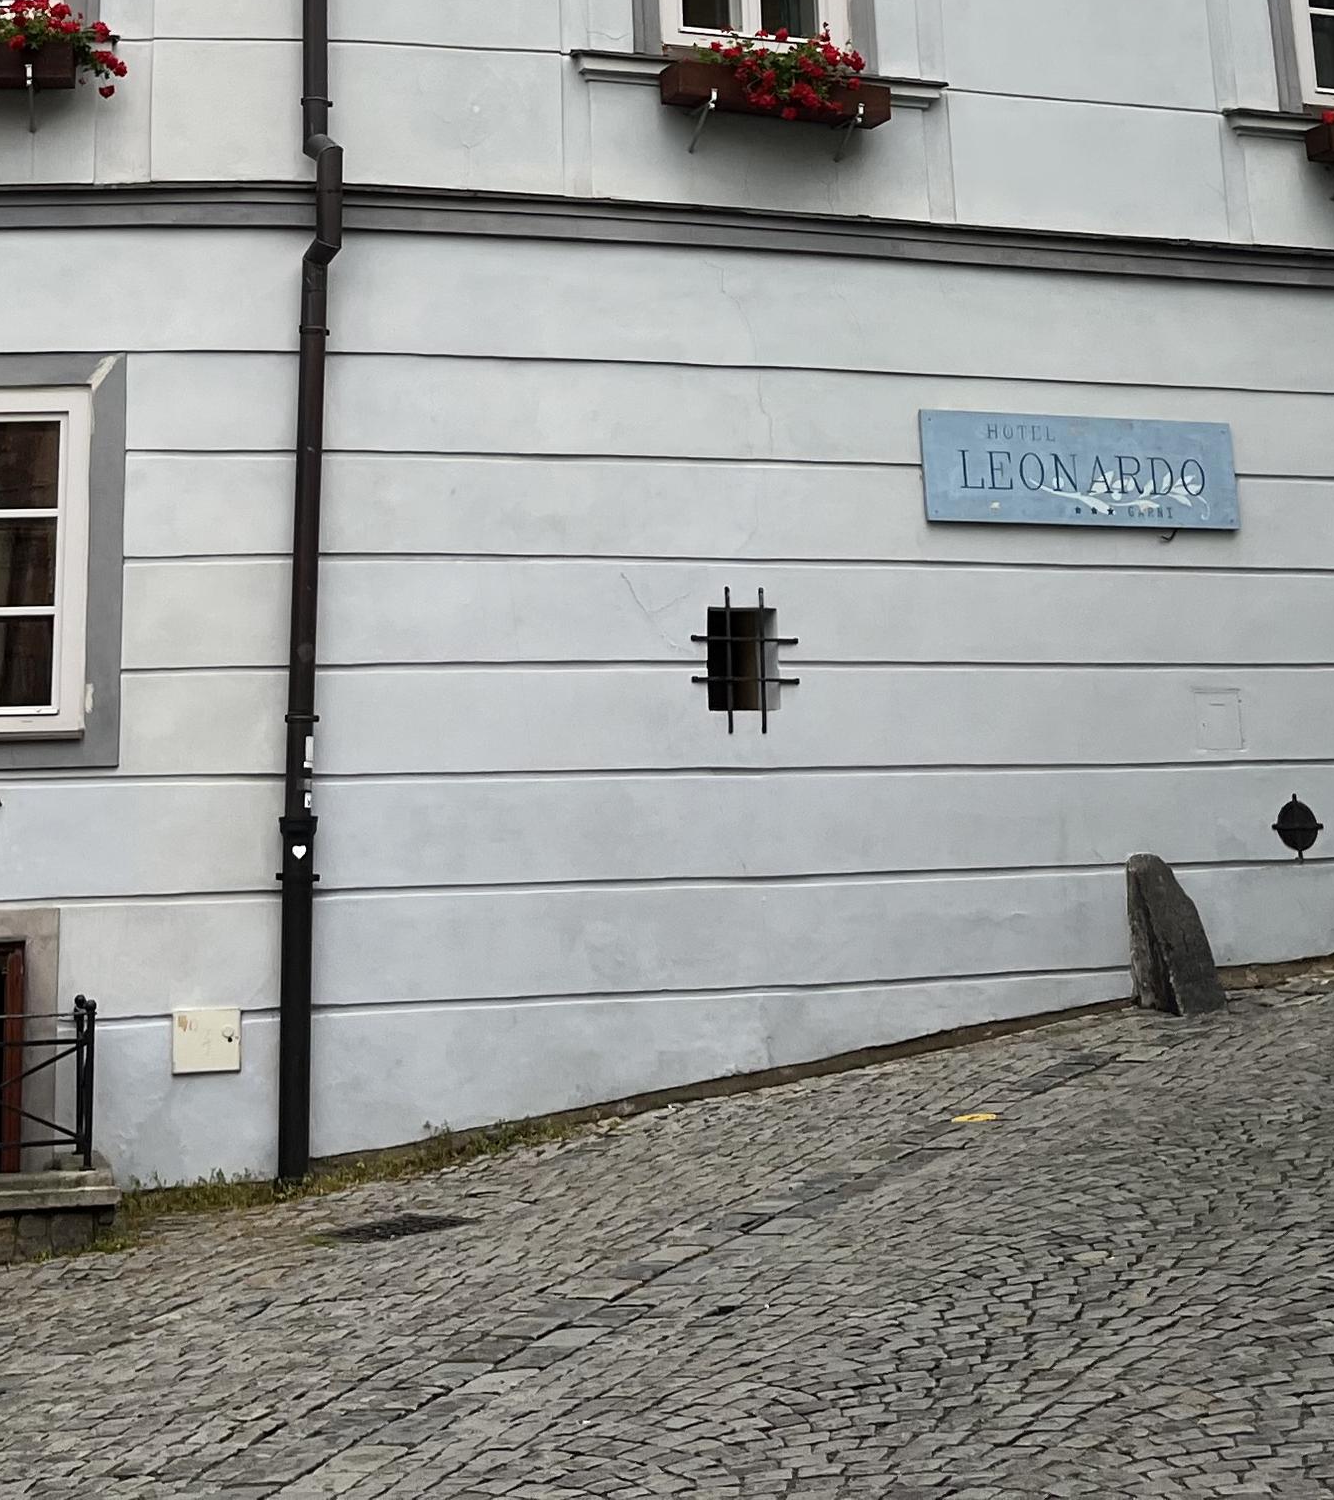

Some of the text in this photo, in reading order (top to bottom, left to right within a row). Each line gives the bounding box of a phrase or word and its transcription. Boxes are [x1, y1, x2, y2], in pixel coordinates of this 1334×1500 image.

[986, 423, 1056, 442] HOTEL
[957, 449, 1205, 496] LEONARDO
[1128, 506, 1174, 519] GARNI
